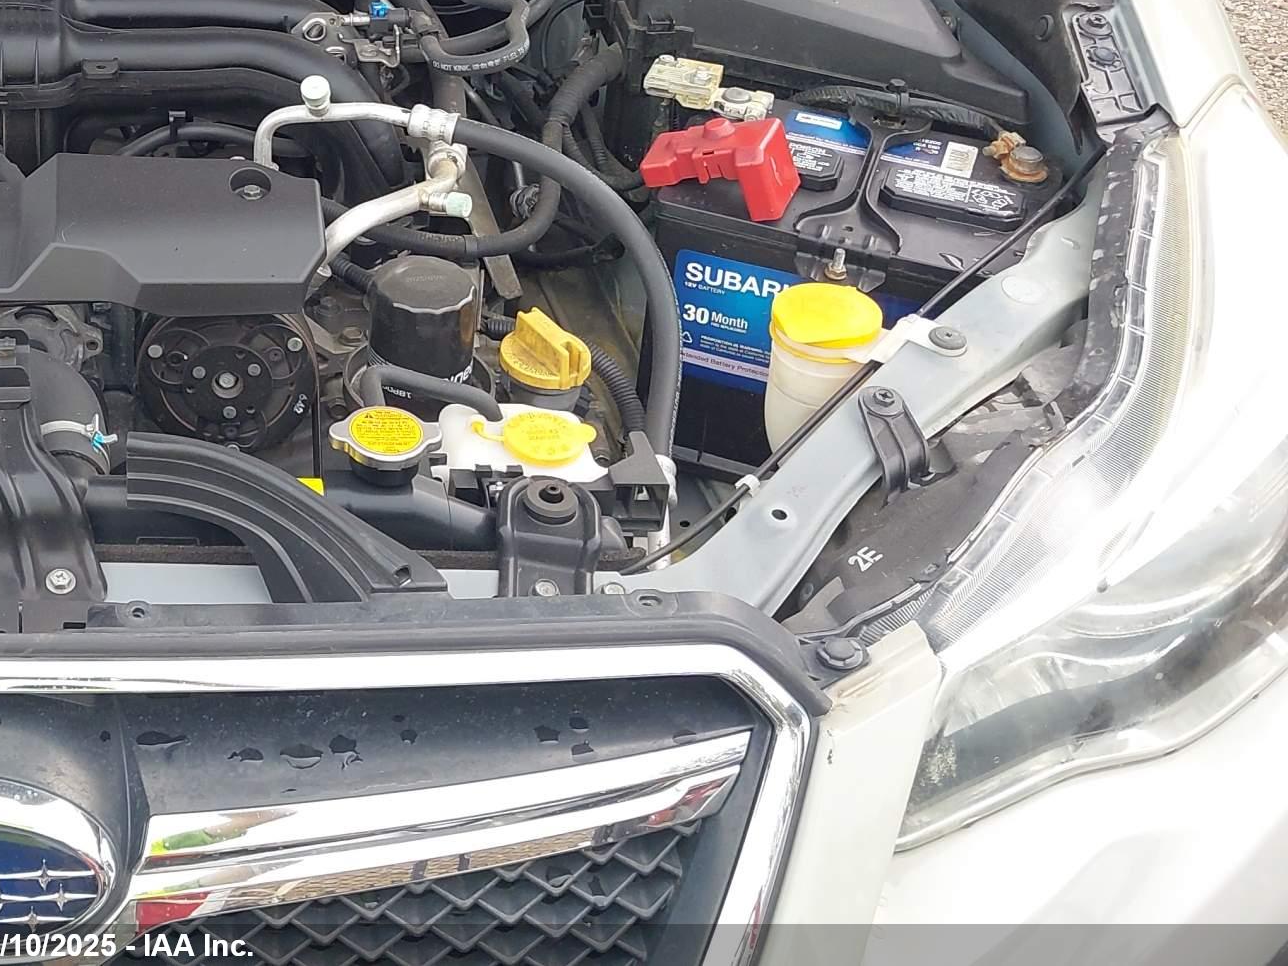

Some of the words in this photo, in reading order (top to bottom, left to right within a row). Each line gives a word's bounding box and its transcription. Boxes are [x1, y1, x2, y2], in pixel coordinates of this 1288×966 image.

[685, 262, 791, 298] SUBAR
[683, 303, 710, 325] 30
[711, 311, 748, 330] Month
[710, 357, 736, 370] Battery
[847, 546, 884, 572] 2E
